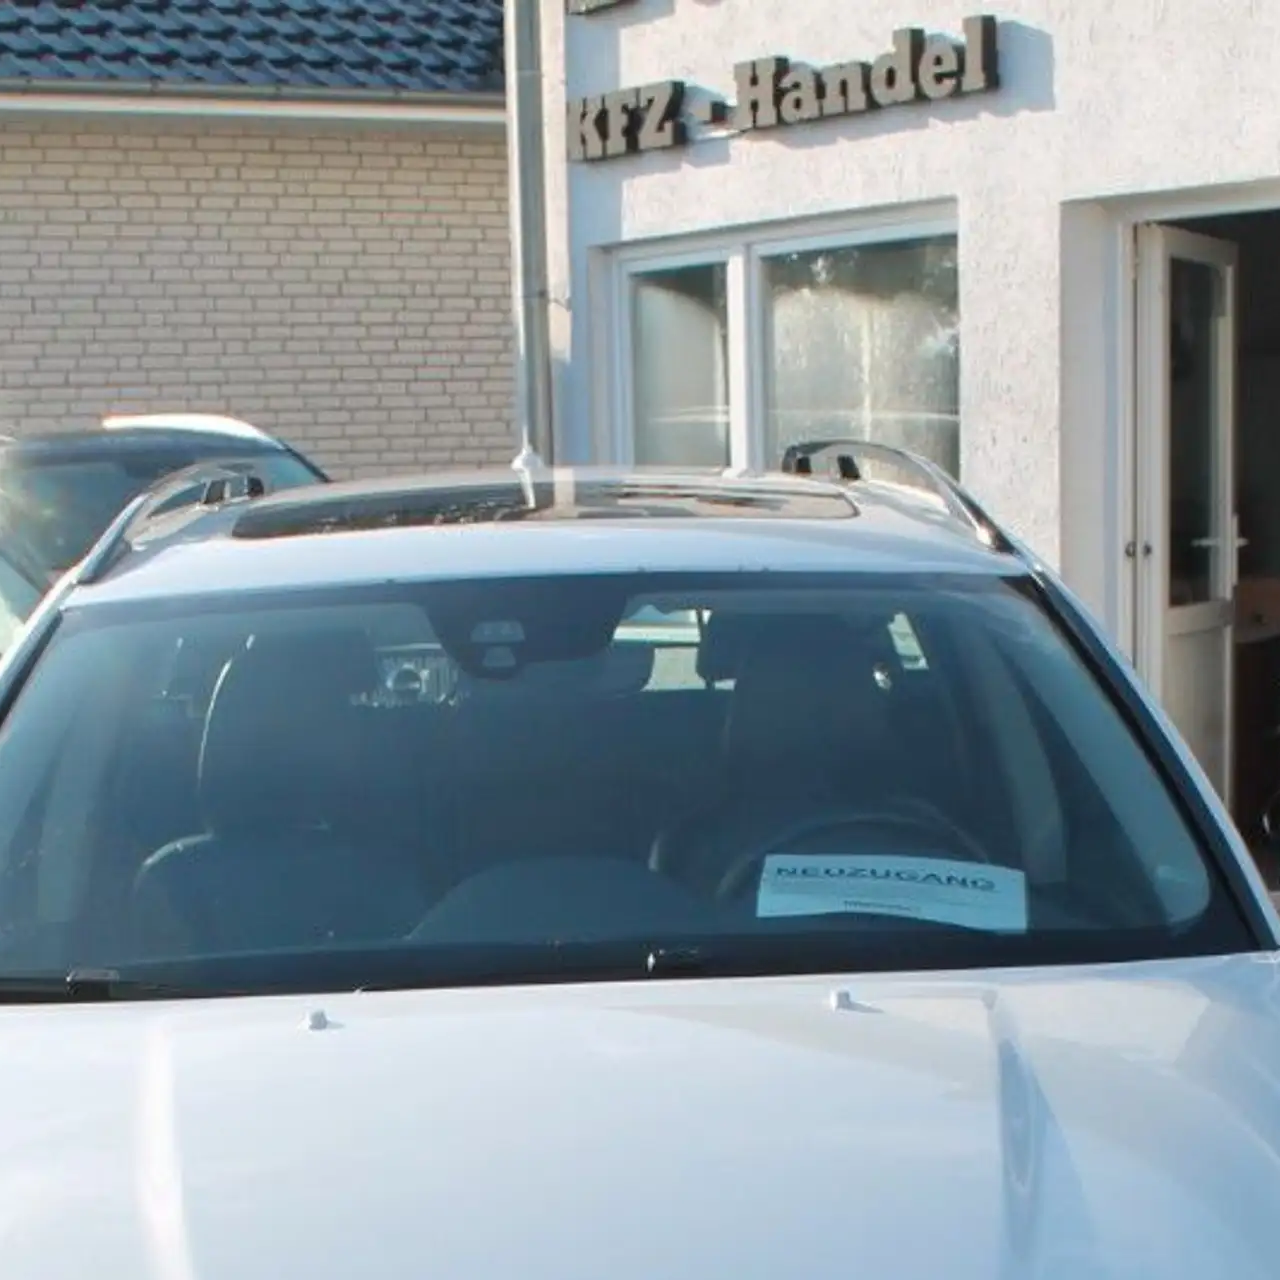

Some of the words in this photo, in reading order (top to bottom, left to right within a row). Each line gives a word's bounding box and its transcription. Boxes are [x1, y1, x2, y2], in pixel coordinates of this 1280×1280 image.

[567, 81, 686, 160] KFZ
[732, 15, 1000, 131] Handel
[775, 866, 997, 893] NEUZUGANG
